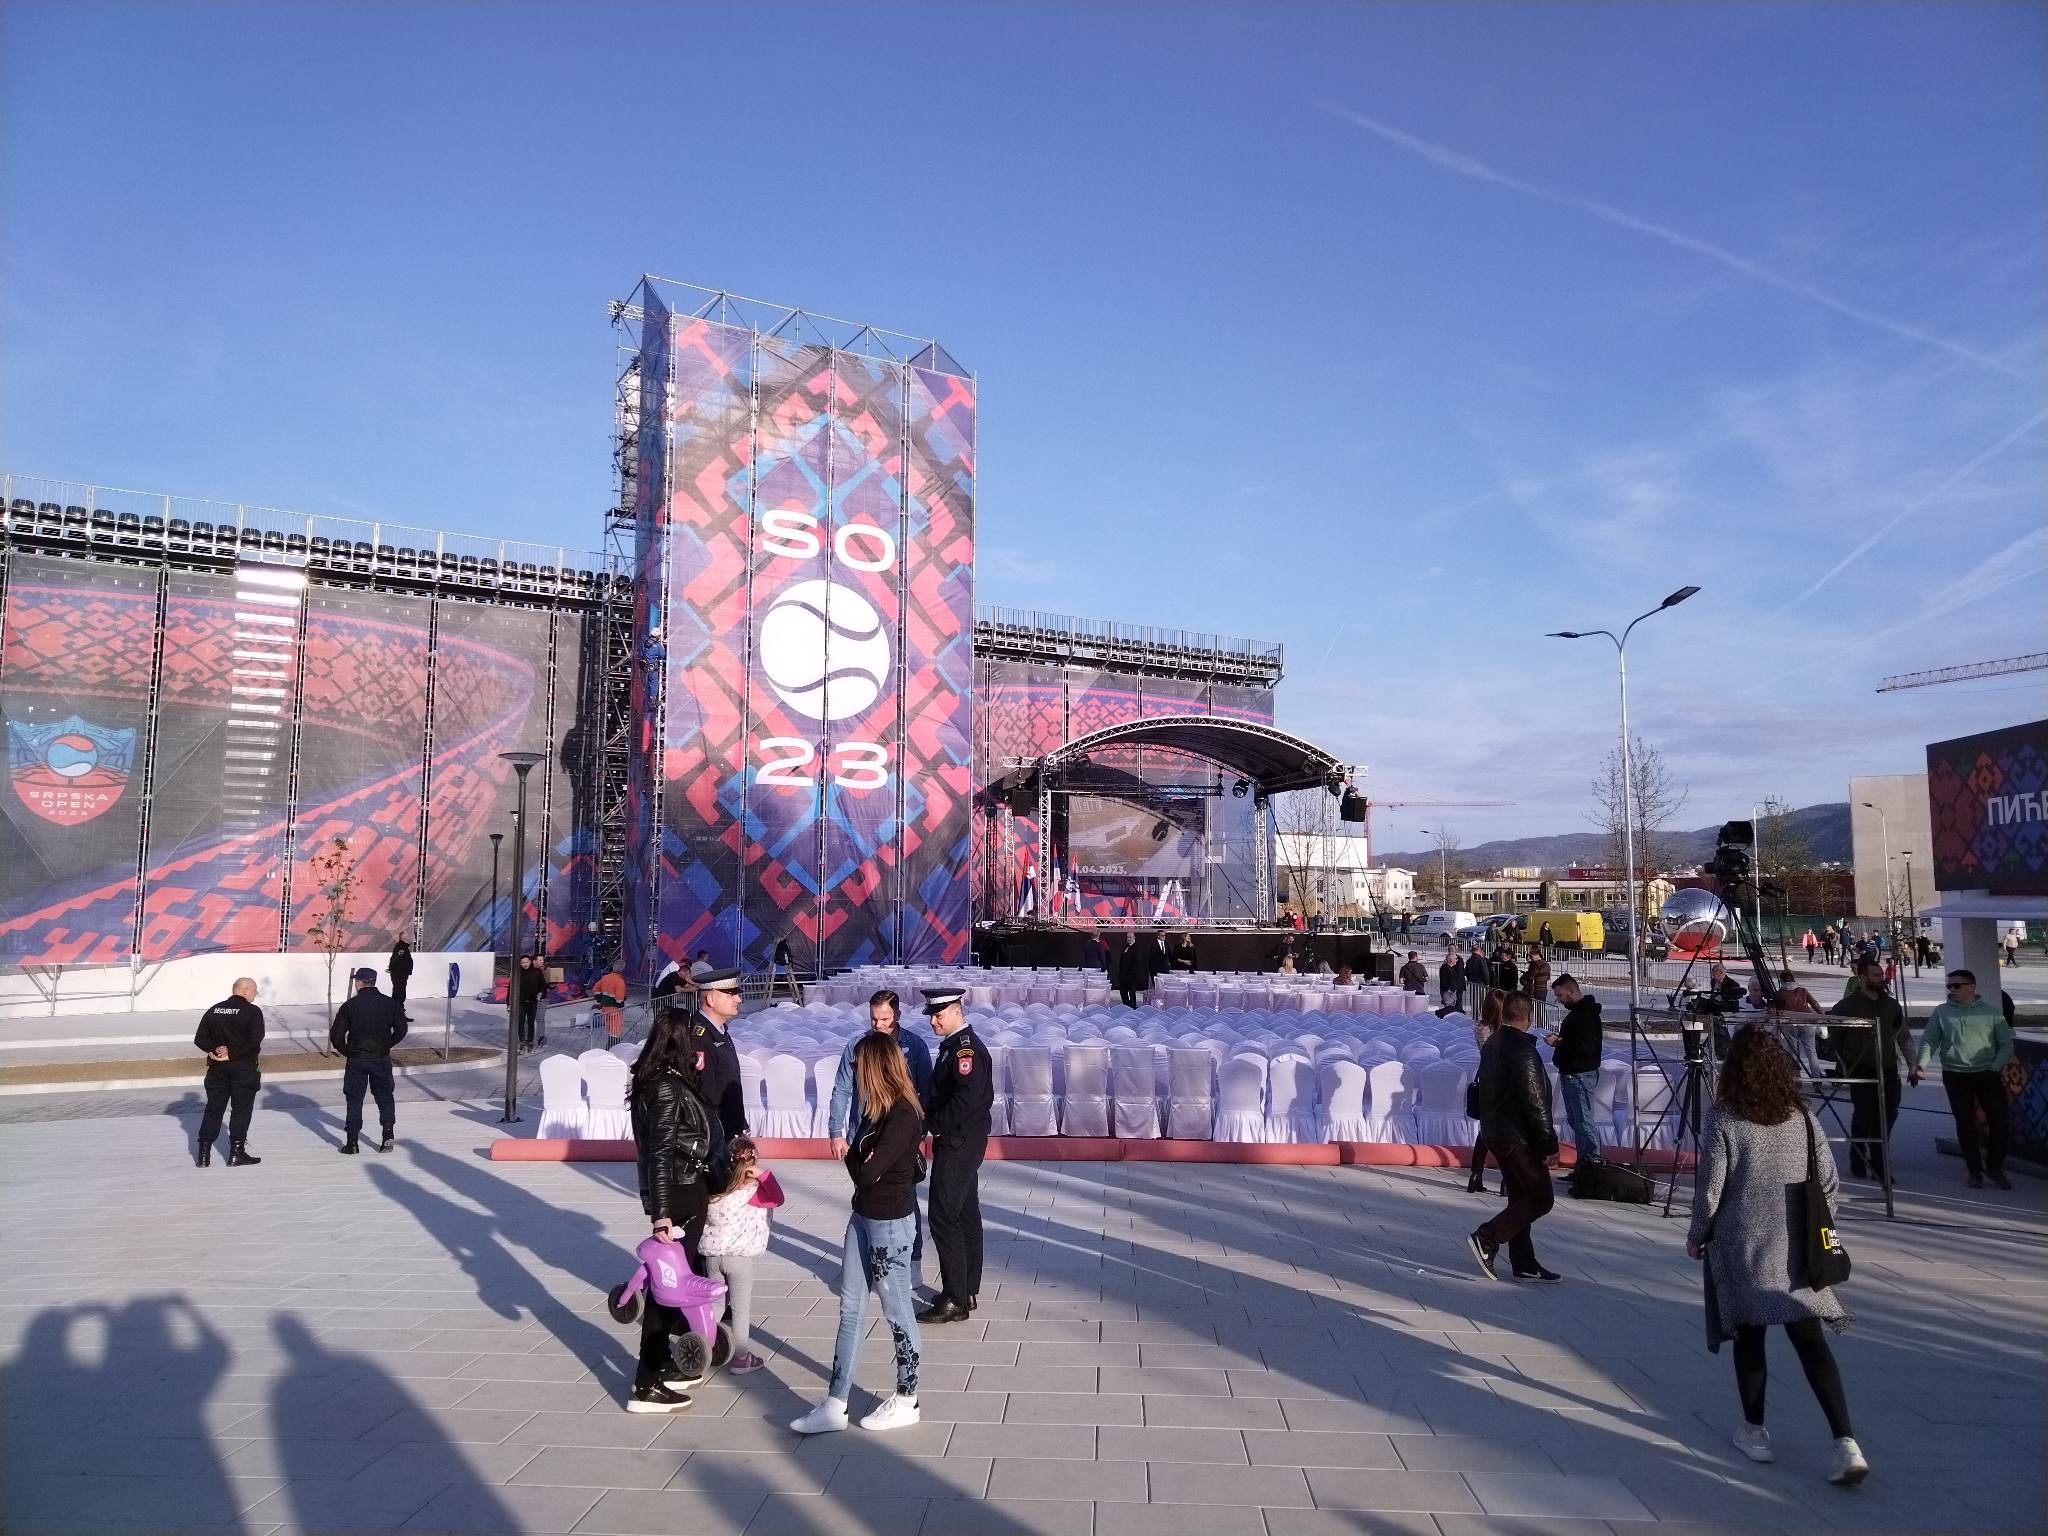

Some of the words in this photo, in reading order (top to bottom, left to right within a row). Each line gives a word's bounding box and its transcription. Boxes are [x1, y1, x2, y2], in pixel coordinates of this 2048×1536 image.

[762, 509, 895, 572] SO
[755, 736, 889, 789] 23
[29, 791, 108, 800] SRPSKA
[41, 800, 95, 809] OPEN
[213, 1007, 240, 1015] SECURITY
